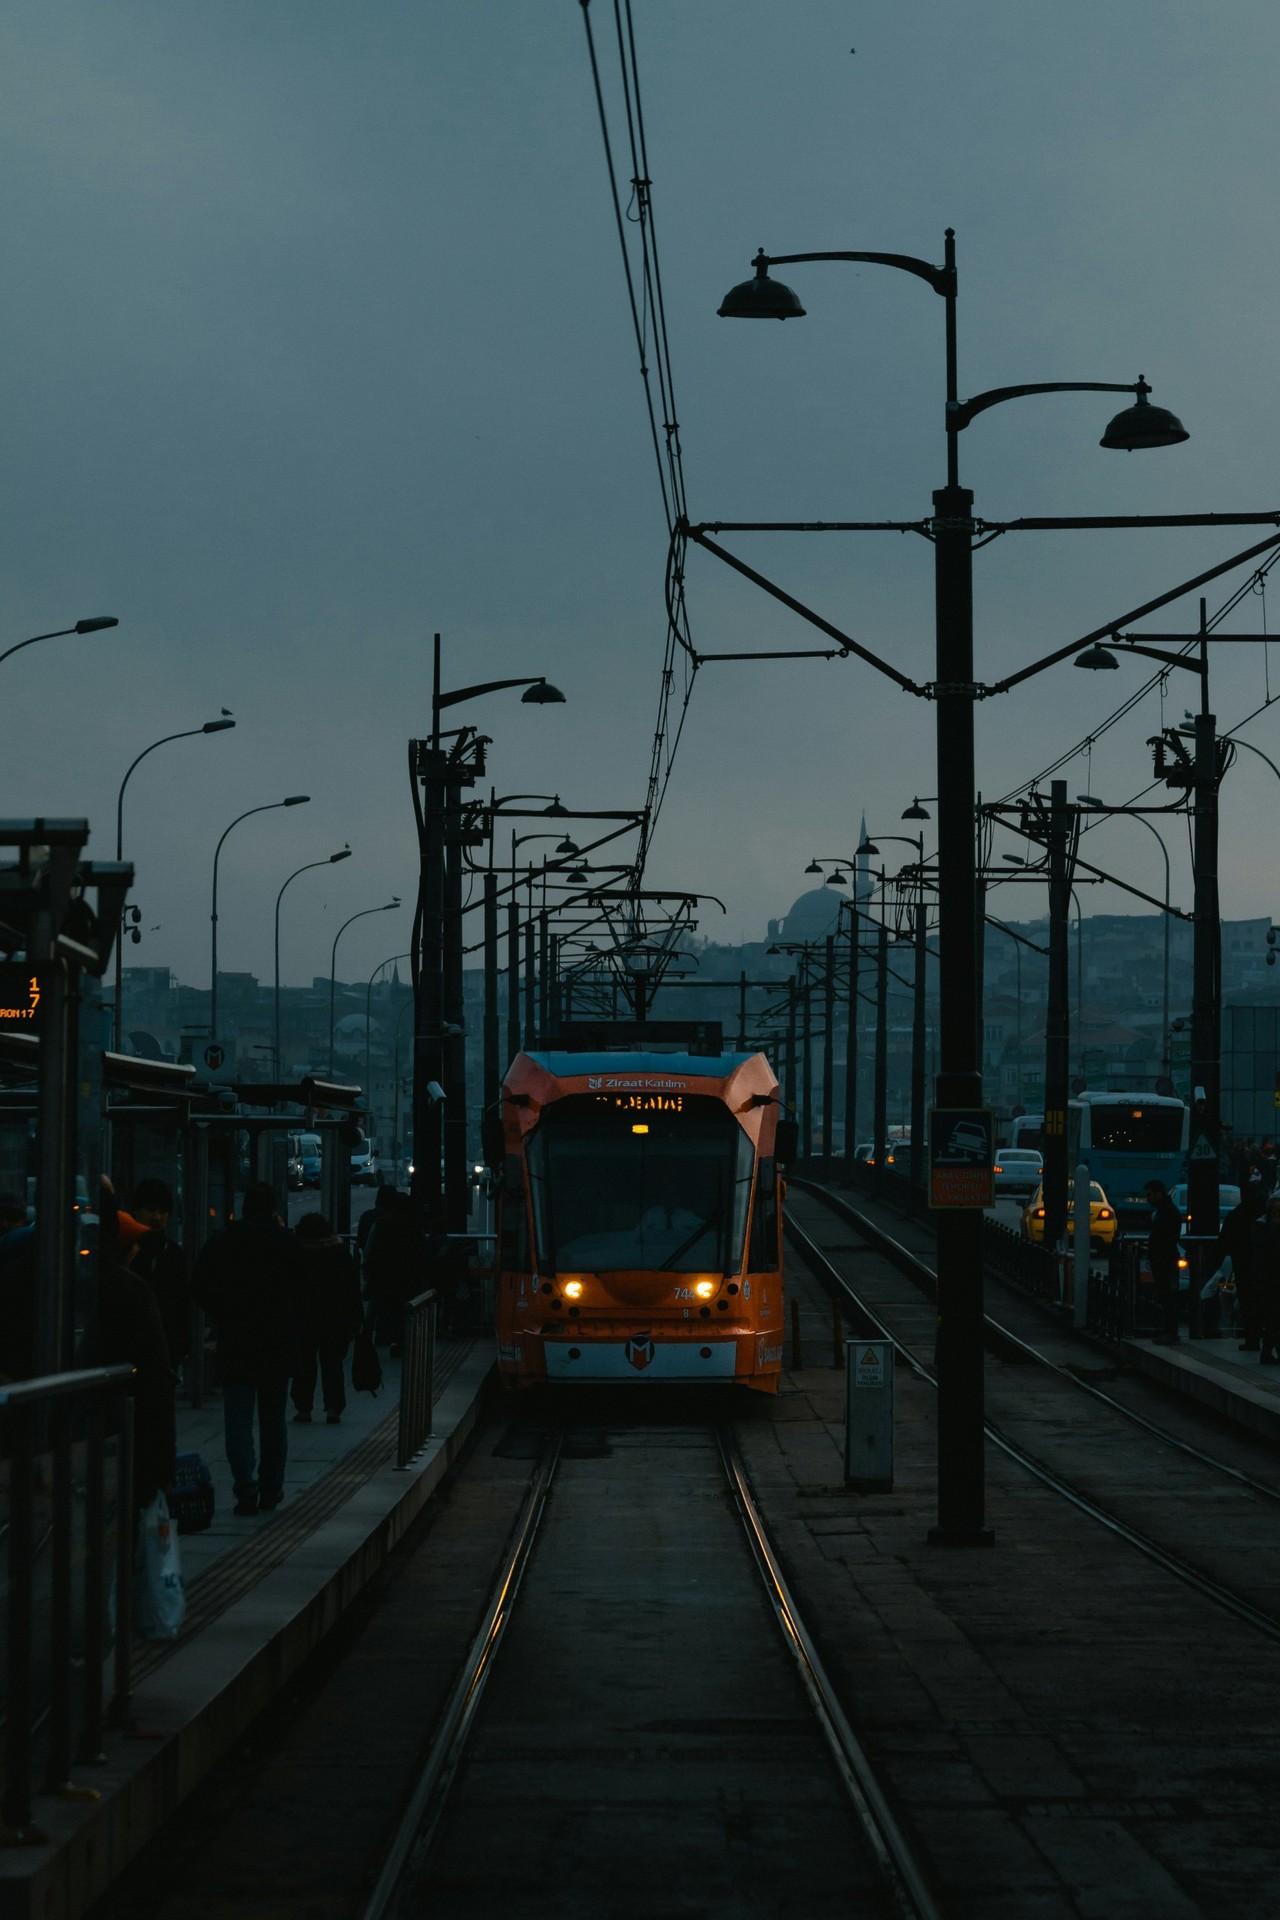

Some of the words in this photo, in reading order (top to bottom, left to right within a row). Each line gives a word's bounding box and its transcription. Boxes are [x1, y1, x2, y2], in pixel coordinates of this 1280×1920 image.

[606, 1078, 644, 1088] Ziraat
[1196, 1143, 1210, 1156] 30
[674, 1287, 695, 1300] 744
